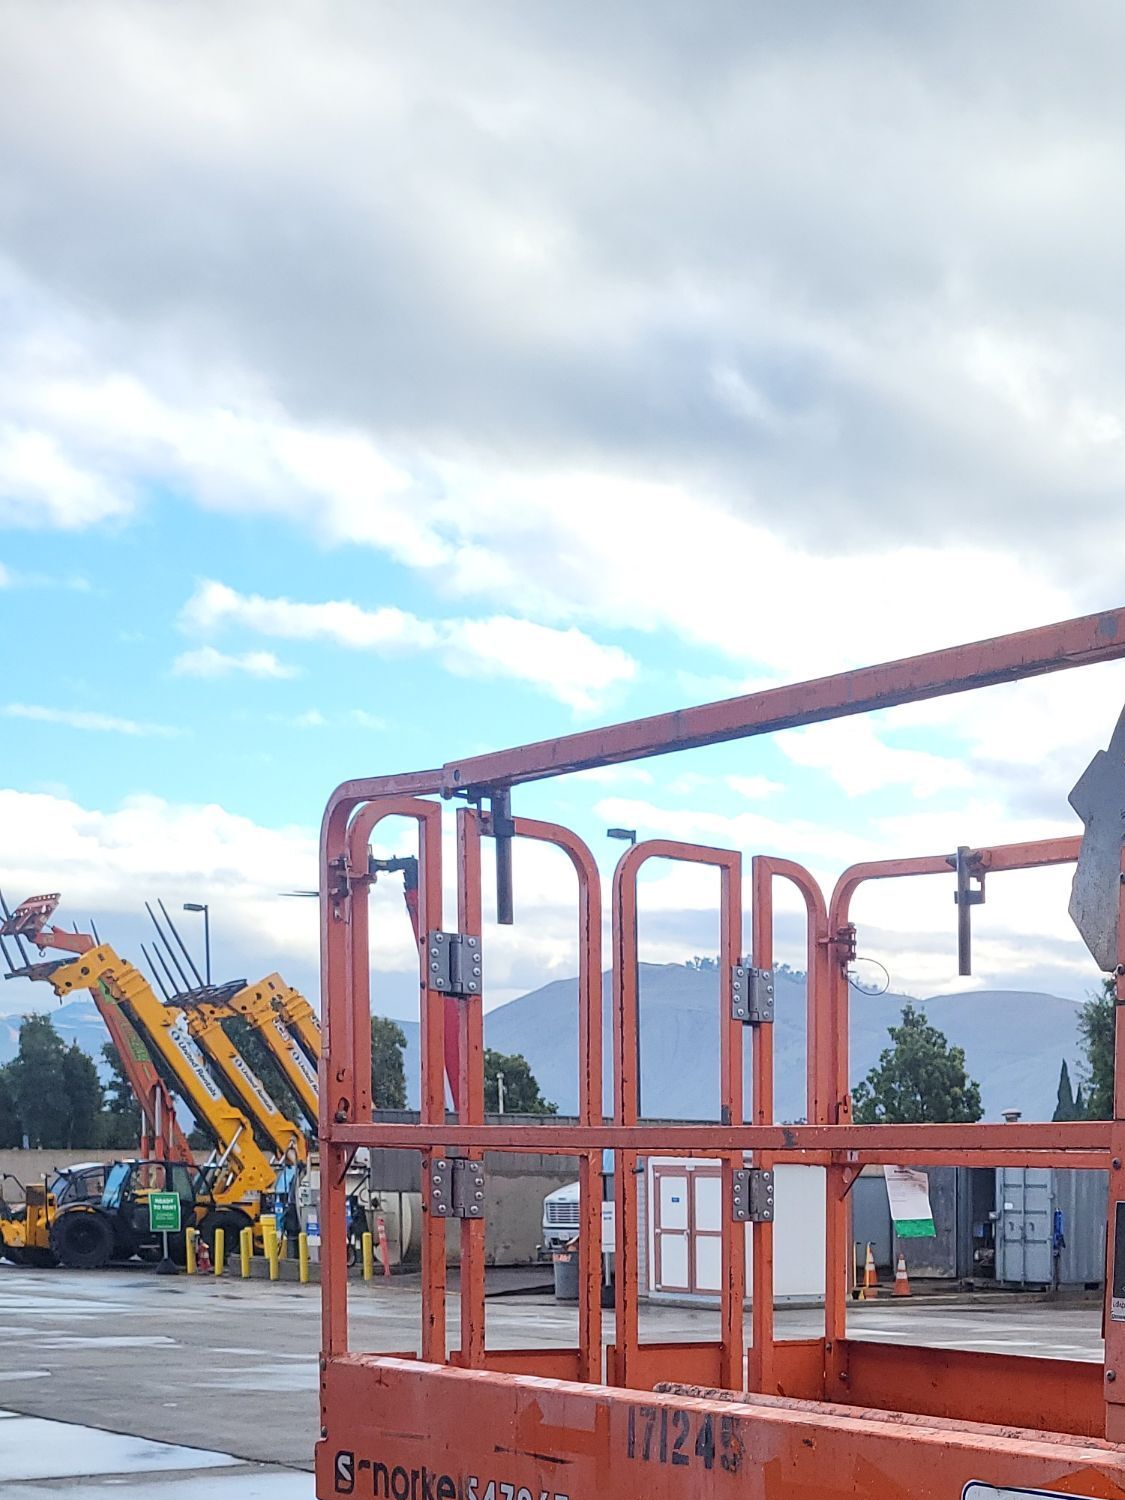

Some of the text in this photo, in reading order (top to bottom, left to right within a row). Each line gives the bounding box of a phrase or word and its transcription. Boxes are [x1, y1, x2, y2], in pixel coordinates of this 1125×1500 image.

[178, 1041, 217, 1097] United Rentals
[626, 1404, 746, 1474] 171245
